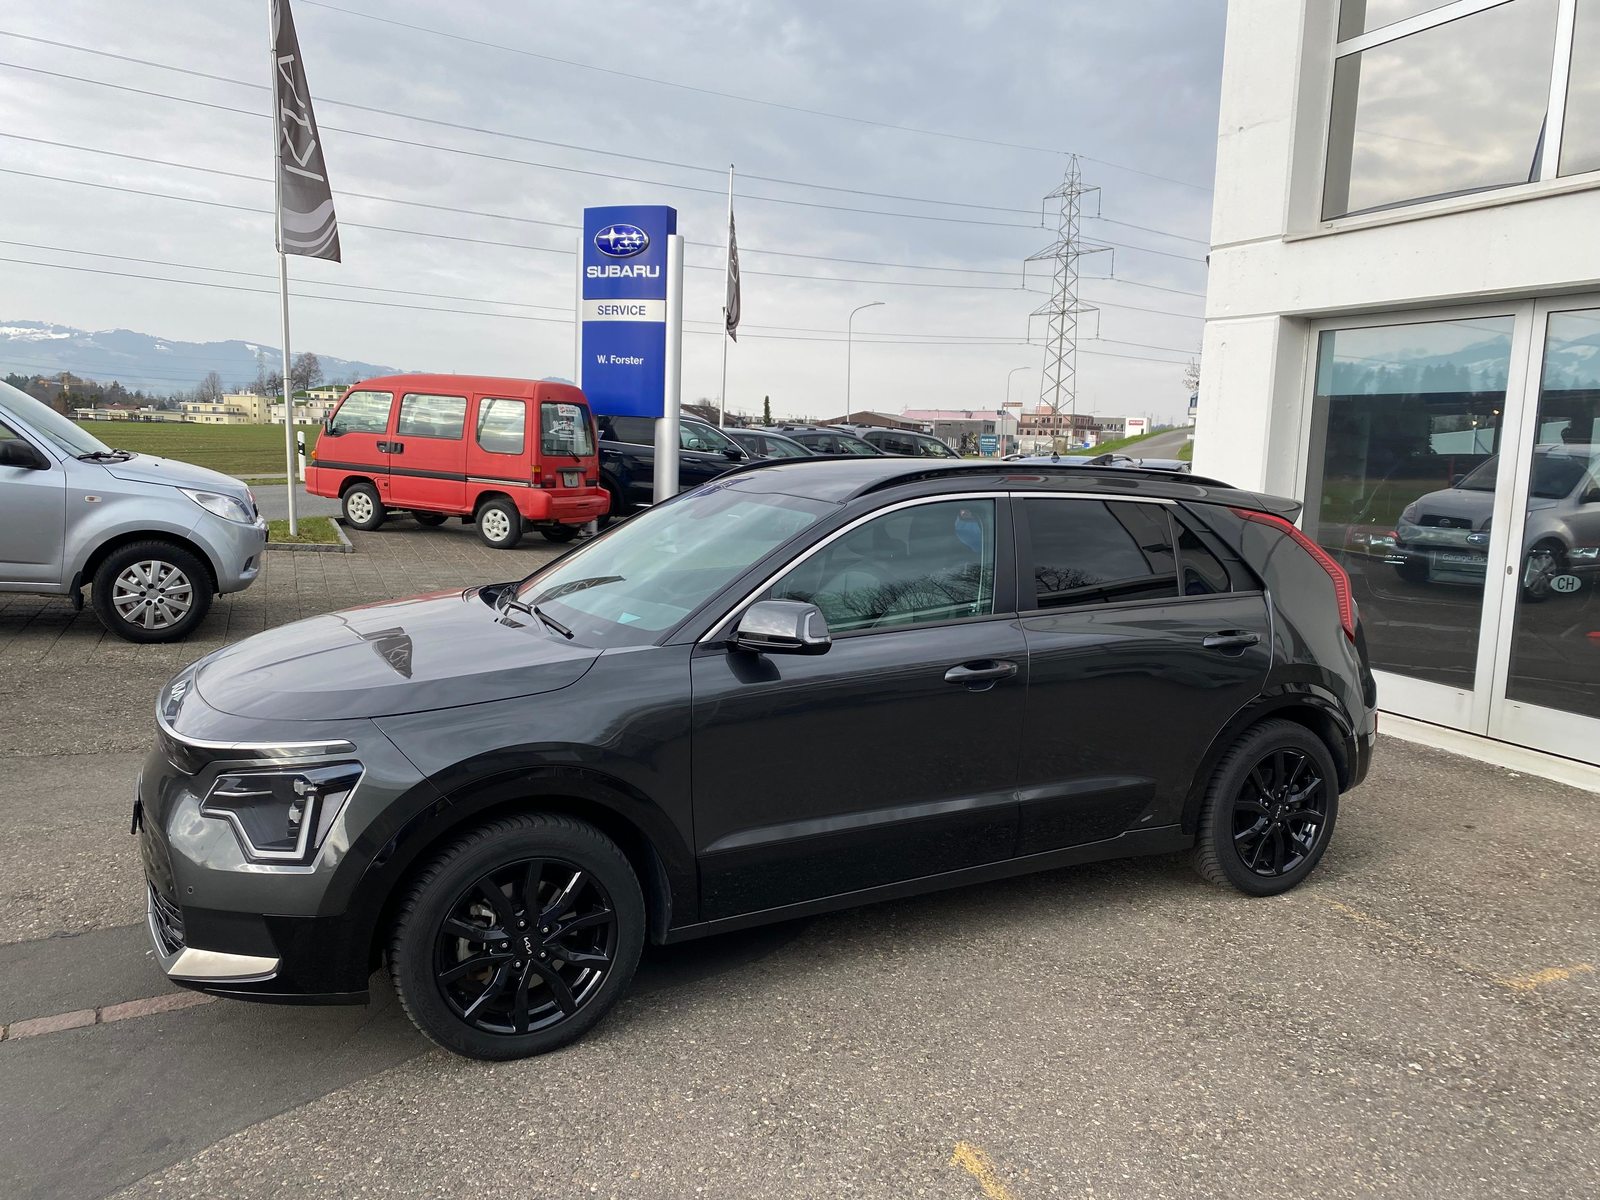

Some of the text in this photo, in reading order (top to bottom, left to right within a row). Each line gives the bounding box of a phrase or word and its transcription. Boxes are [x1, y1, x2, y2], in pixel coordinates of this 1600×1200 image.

[278, 54, 324, 182] KIA
[586, 265, 660, 278] SUBARU
[597, 305, 646, 316] SERVICE
[597, 355, 644, 365] W. Forster
[1557, 577, 1575, 590] CH
